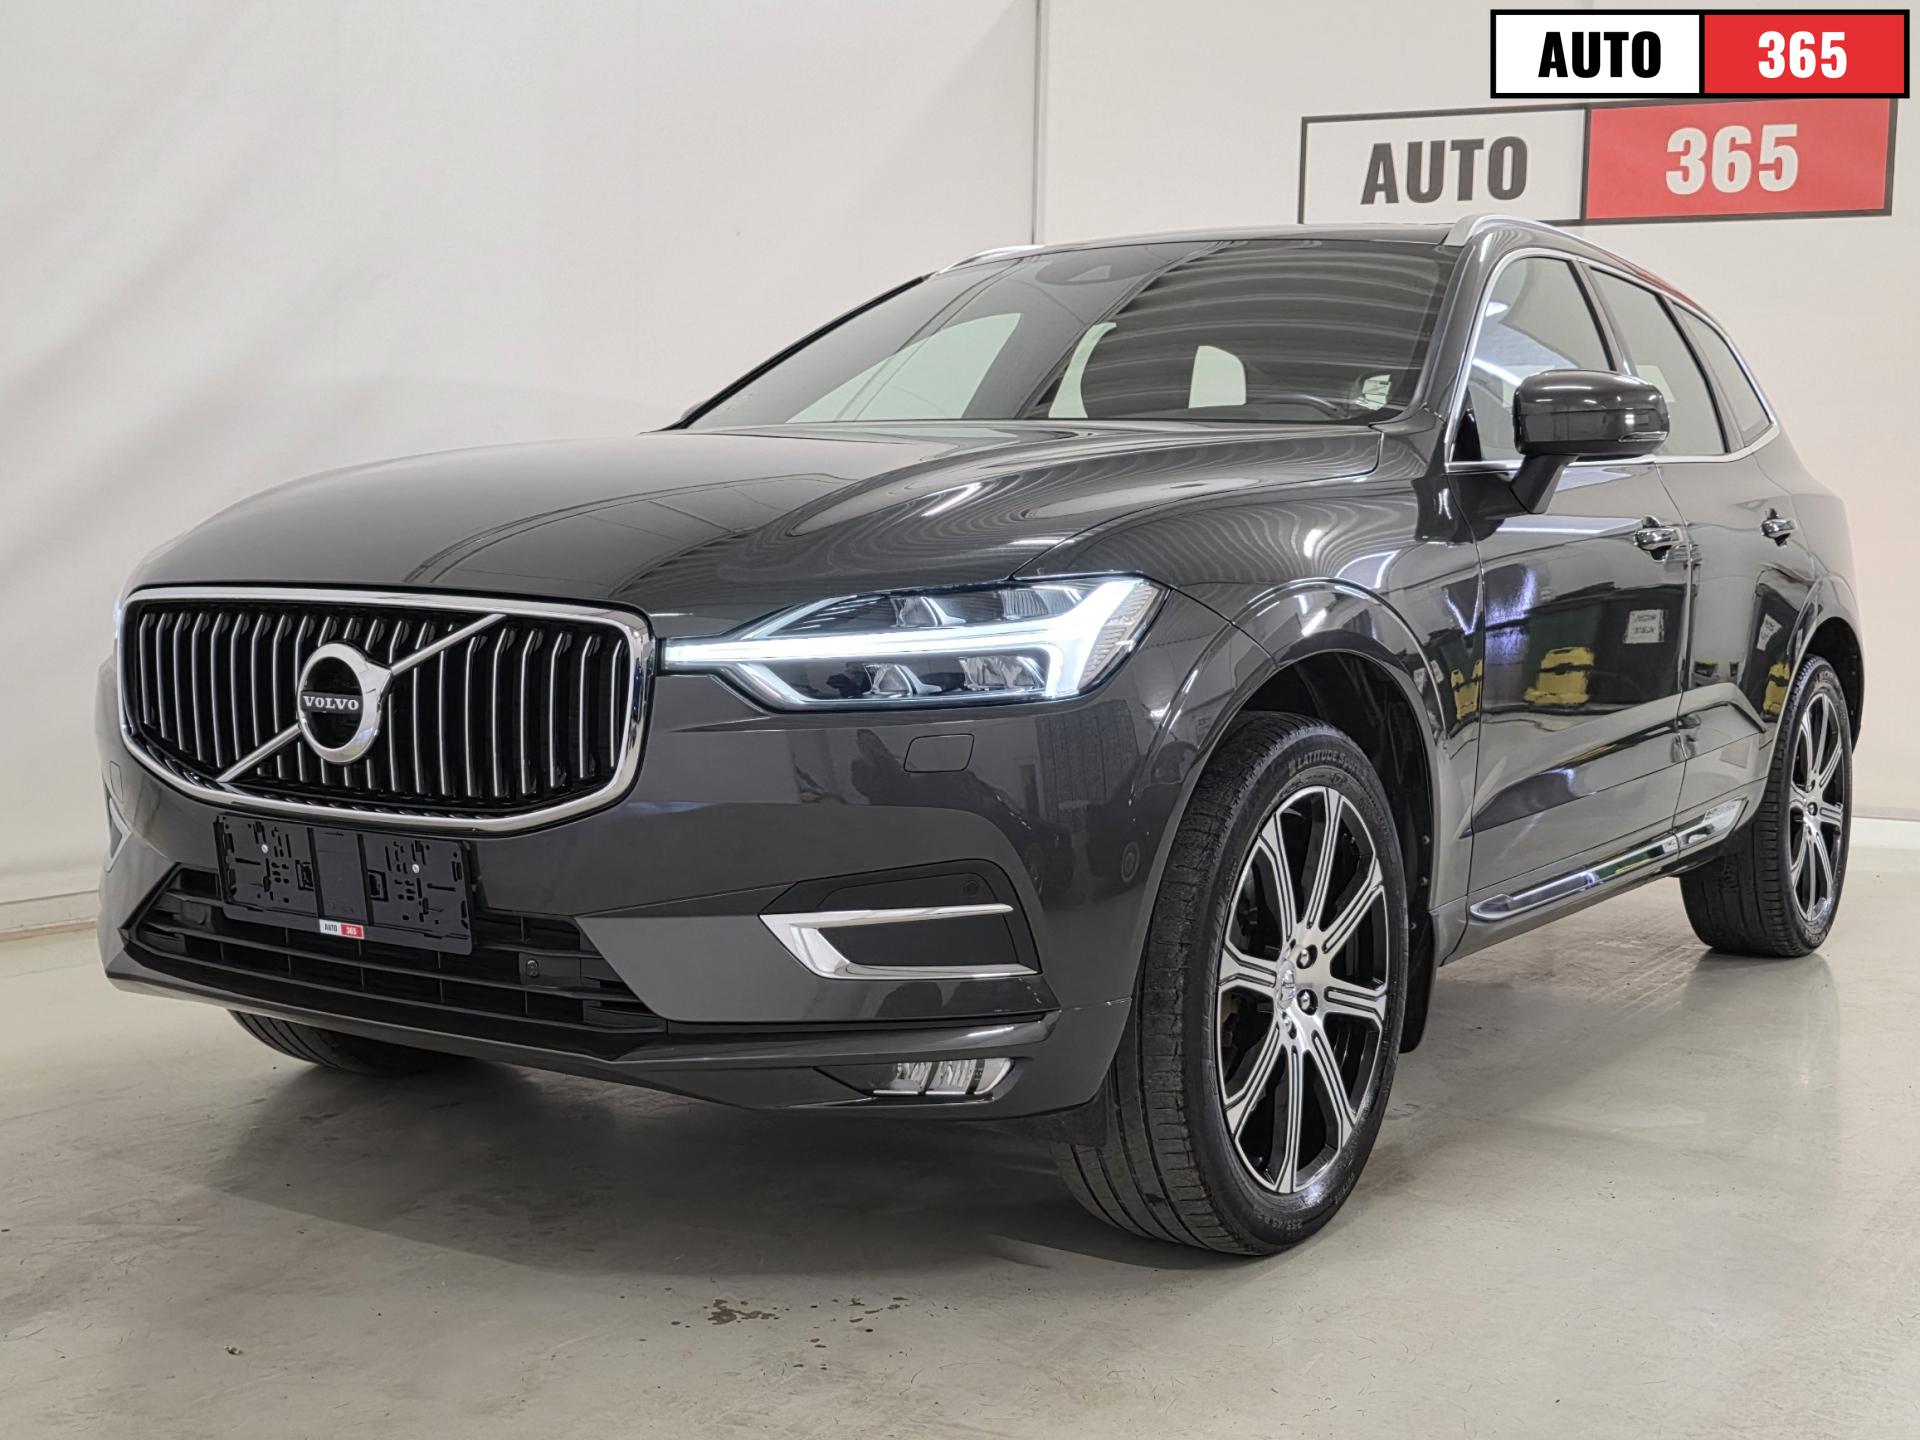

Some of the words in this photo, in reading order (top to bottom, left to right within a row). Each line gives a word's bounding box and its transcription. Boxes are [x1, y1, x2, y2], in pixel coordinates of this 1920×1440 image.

[1360, 136, 1528, 205] AUTO
[1665, 124, 1799, 195] 365
[302, 695, 359, 710] VOLVO
[1297, 749, 1338, 769] LATITUDE
[324, 923, 338, 933] AUTO
